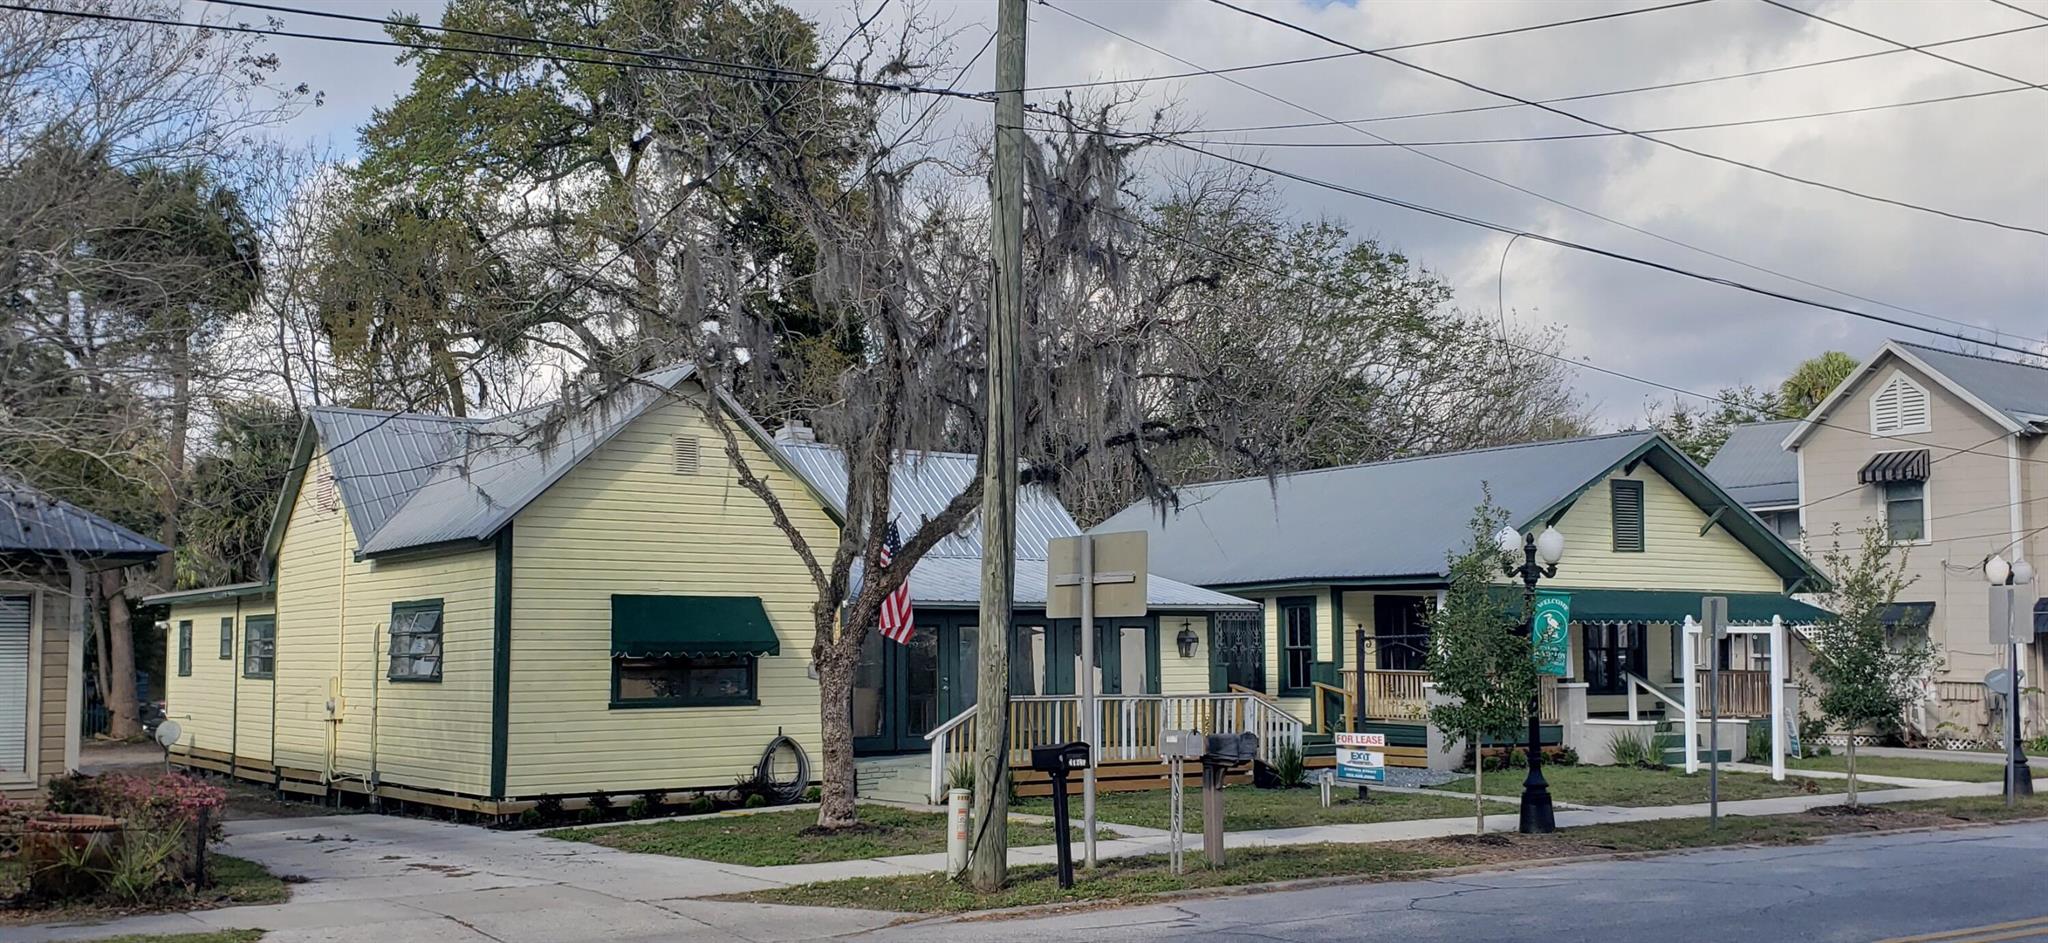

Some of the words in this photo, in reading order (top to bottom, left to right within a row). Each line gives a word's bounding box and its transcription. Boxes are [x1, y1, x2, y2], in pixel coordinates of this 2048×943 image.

[1537, 599, 1568, 610] WELCOME
[1336, 734, 1353, 744] FOR
[1356, 735, 1383, 745] LEASE
[1351, 752, 1370, 760] EXIT
